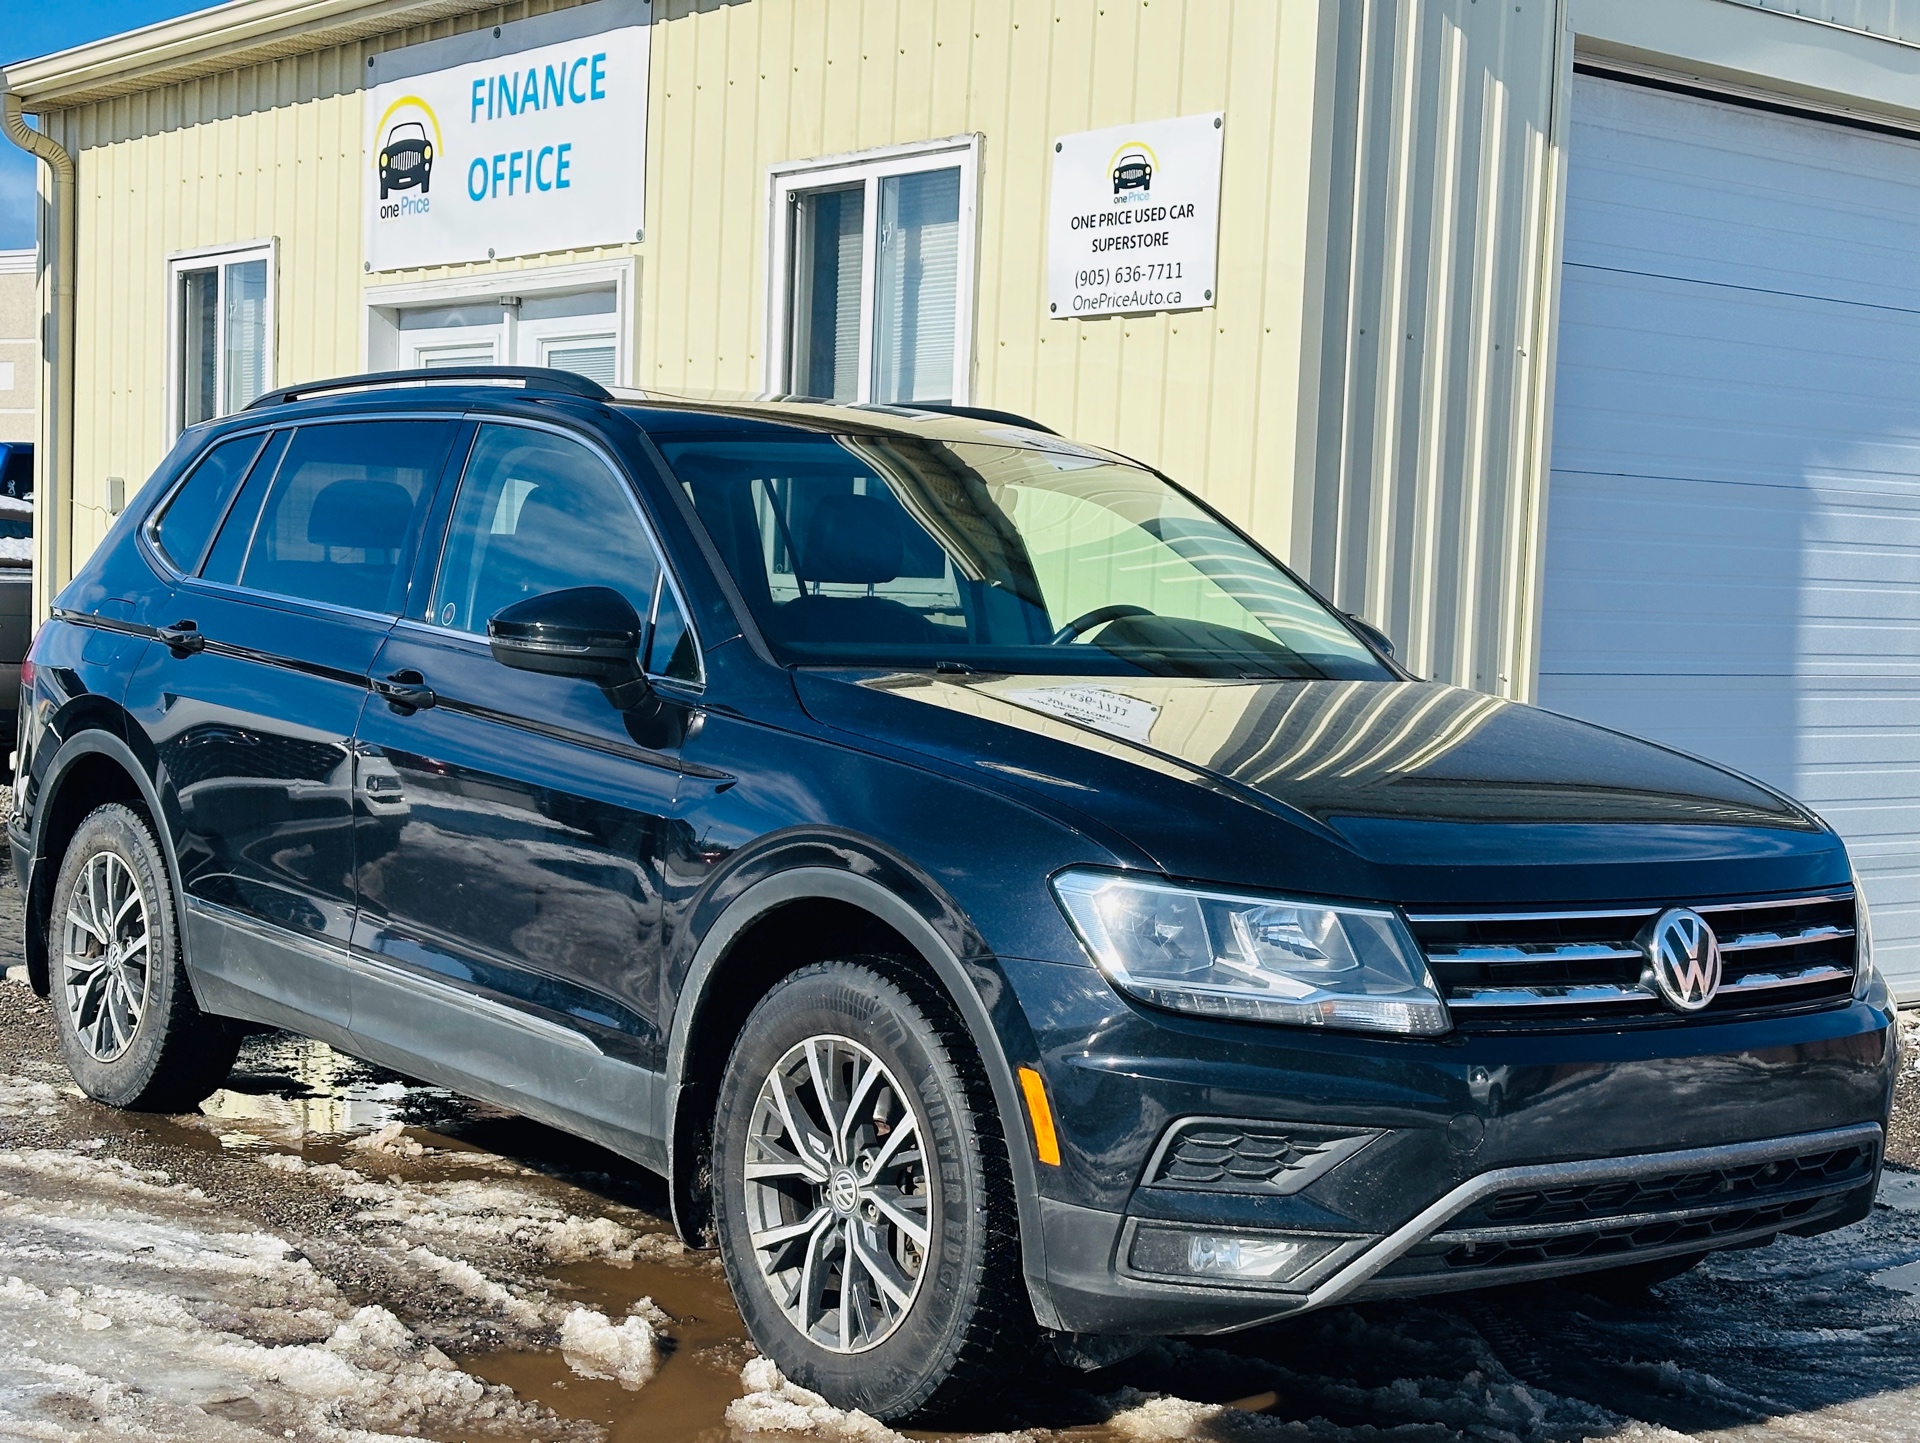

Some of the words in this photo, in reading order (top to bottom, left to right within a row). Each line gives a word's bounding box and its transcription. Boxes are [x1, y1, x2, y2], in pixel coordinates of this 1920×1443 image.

[471, 52, 607, 124] FINANCE
[467, 143, 572, 202] OFFICE
[1071, 214, 1096, 230] ONE
[1098, 210, 1132, 228] PRICE
[1134, 206, 1167, 224] USED
[1169, 203, 1195, 221] CAR
[1091, 231, 1170, 253] SUPERSTORE
[1072, 290, 1182, 311] OnePriceAuto.ca
[1074, 268, 1110, 289] (905)
[1115, 262, 1183, 284] 636-7711
[1654, 909, 1721, 1009] VW
[918, 1074, 963, 1204] WINTER
[934, 1218, 963, 1305] EDGE
